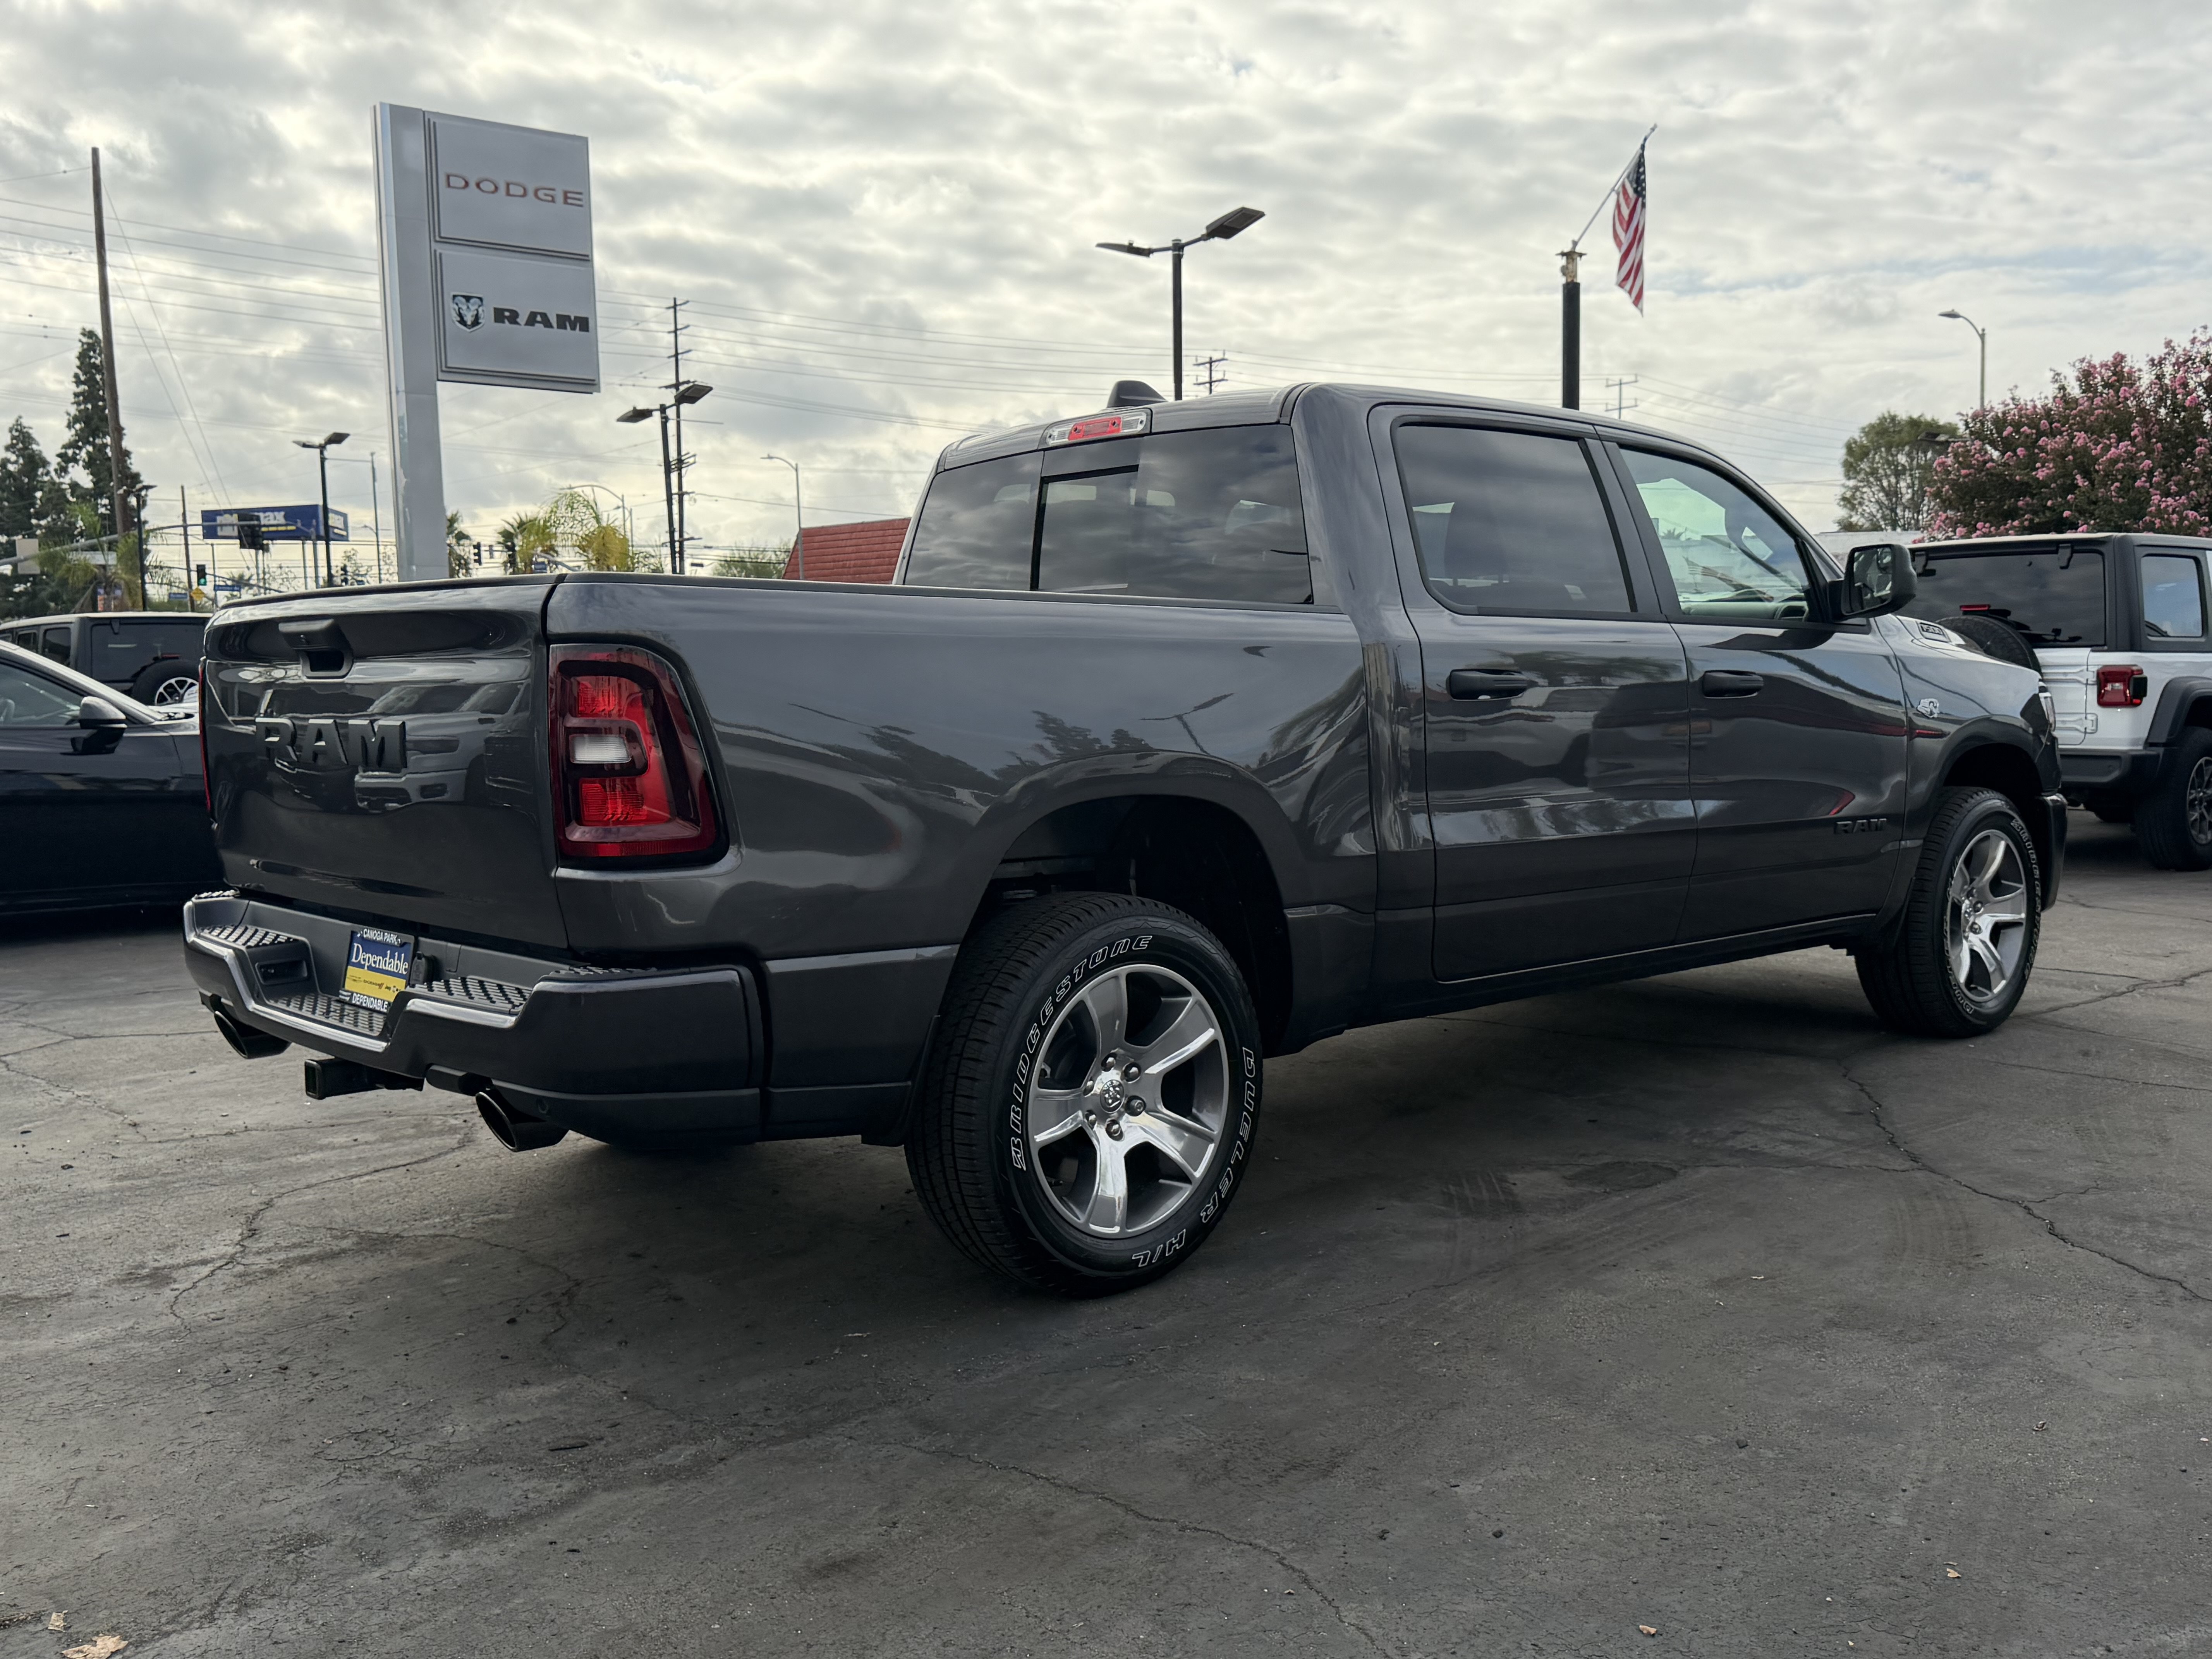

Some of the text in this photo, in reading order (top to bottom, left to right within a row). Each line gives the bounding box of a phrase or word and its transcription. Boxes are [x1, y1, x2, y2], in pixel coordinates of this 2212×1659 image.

[446, 173, 584, 207] DODGE
[493, 307, 590, 333] RAM
[255, 717, 408, 769] RAM
[1834, 818, 1887, 834] RAM
[363, 929, 397, 945] CANOGA PARK
[351, 943, 409, 975] Dependable
[352, 993, 388, 1012] DEPENDABLE
[1010, 935, 1152, 1171] BRIDGESTONE
[1132, 1047, 1255, 1267] DUELER H/L
